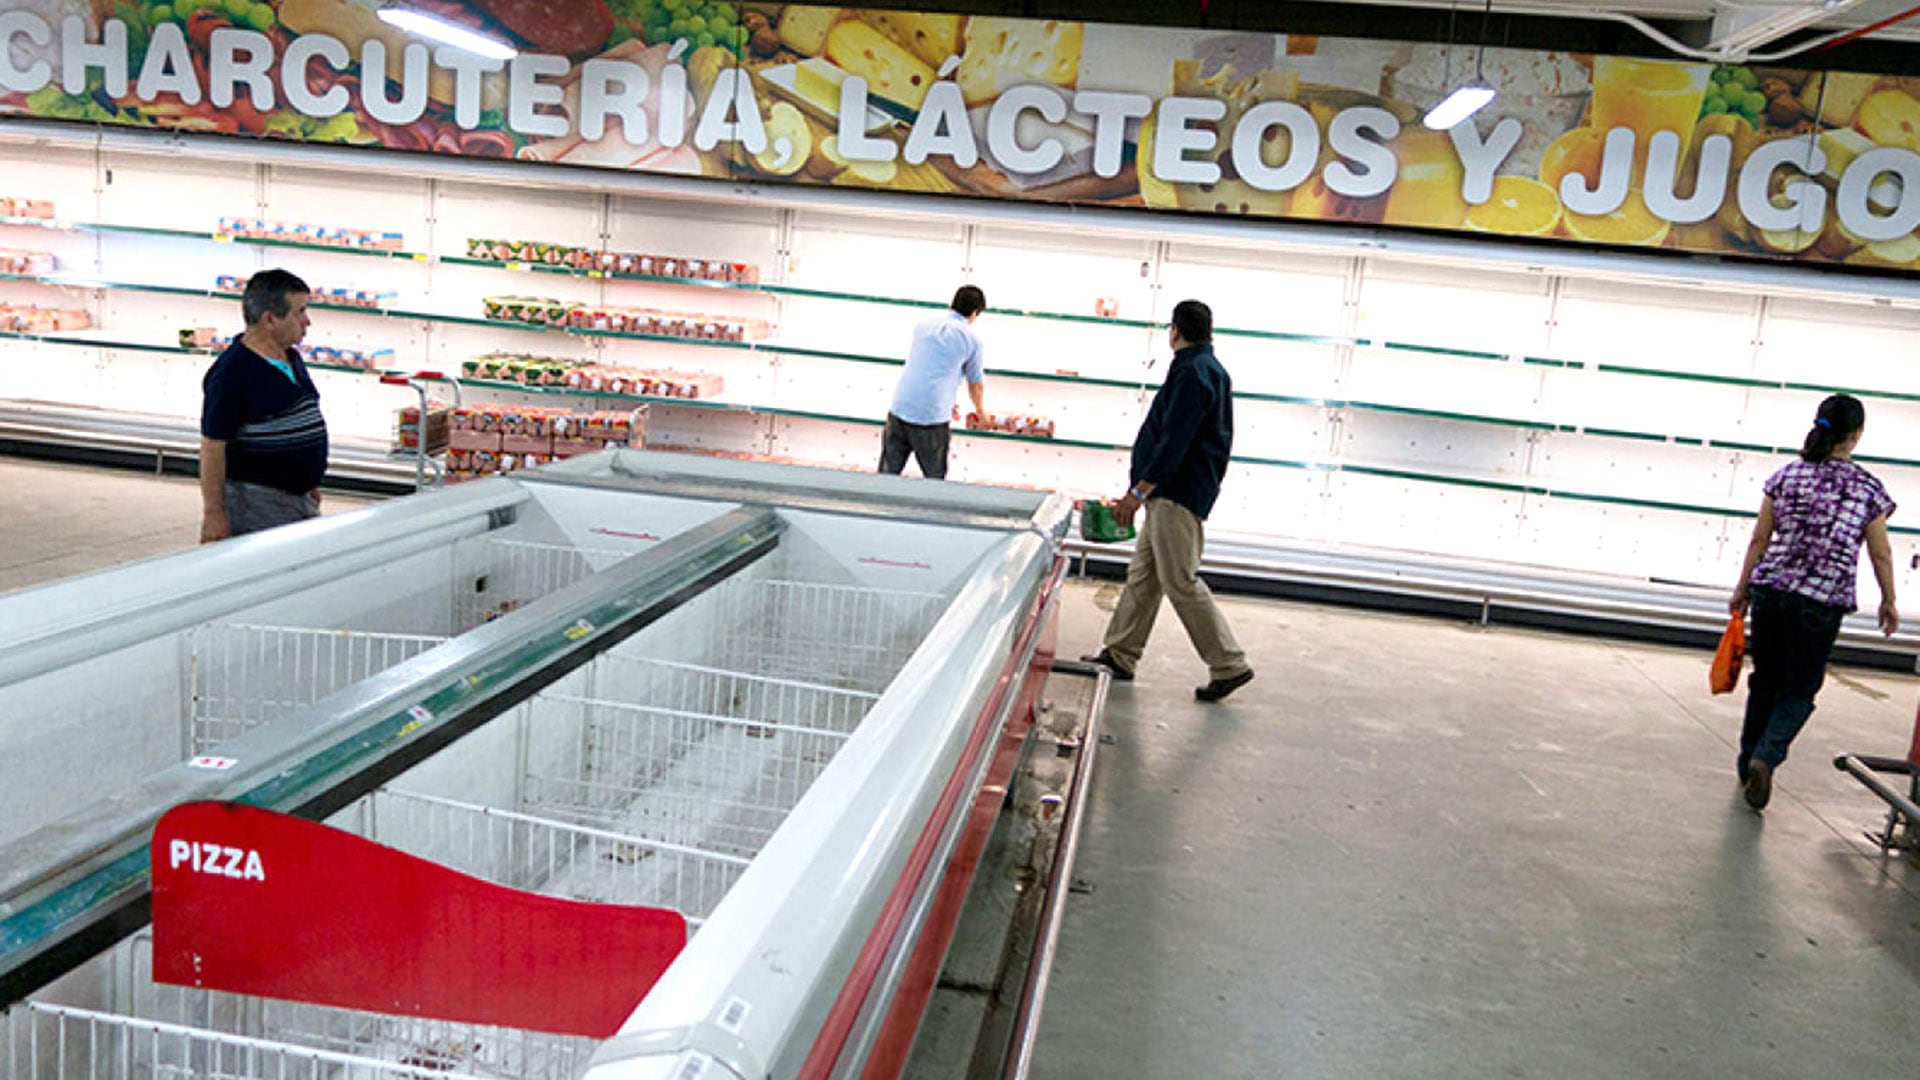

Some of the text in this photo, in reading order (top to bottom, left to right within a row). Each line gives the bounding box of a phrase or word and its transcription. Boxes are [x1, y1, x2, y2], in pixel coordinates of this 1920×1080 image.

[0, 11, 1920, 240] CHARCUTERÍA, LÁCTEOS Y JUGO
[170, 839, 265, 881] PIZZA
